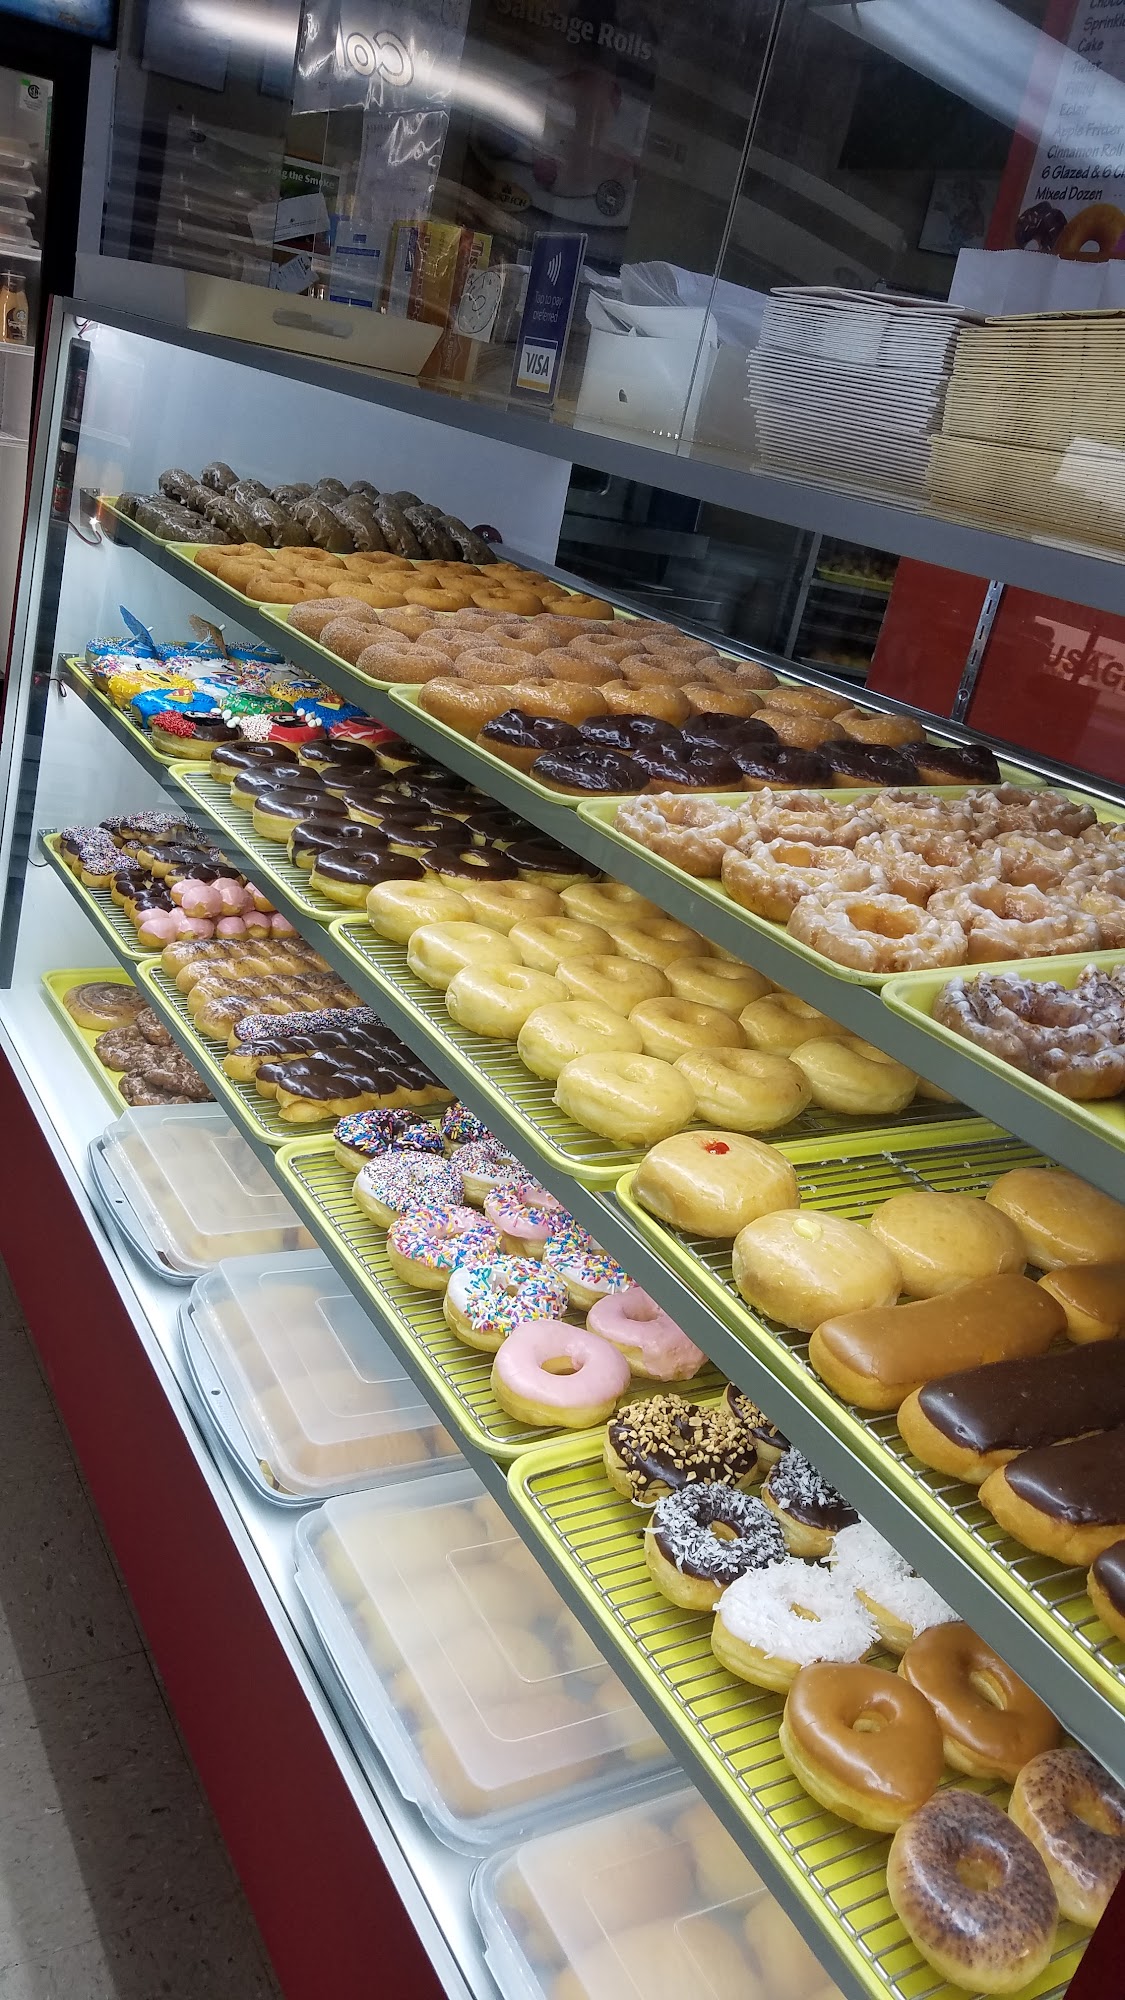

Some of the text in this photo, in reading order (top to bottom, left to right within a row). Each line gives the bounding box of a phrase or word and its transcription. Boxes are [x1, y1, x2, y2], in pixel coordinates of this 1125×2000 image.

[496, 0, 652, 60] Sausage Rolls
[1077, 37, 1104, 53] Cake
[1071, 58, 1103, 75] Twist
[1059, 103, 1090, 117] Eclair
[1053, 121, 1124, 142] Apple Fritter
[1047, 142, 1125, 159] Cinnamon Roll
[289, 170, 304, 182] the
[305, 174, 335, 189] Smoke
[1041, 165, 1051, 179] 6
[1052, 165, 1090, 179] Glazed
[1091, 165, 1101, 179] &
[1102, 165, 1112, 179] 6
[1035, 185, 1103, 201] Mixed Dozen
[535, 290, 564, 309] Tap to pay
[532, 308, 559, 323] preferred
[525, 352, 550, 377] VISA
[1046, 645, 1125, 688] USAG
